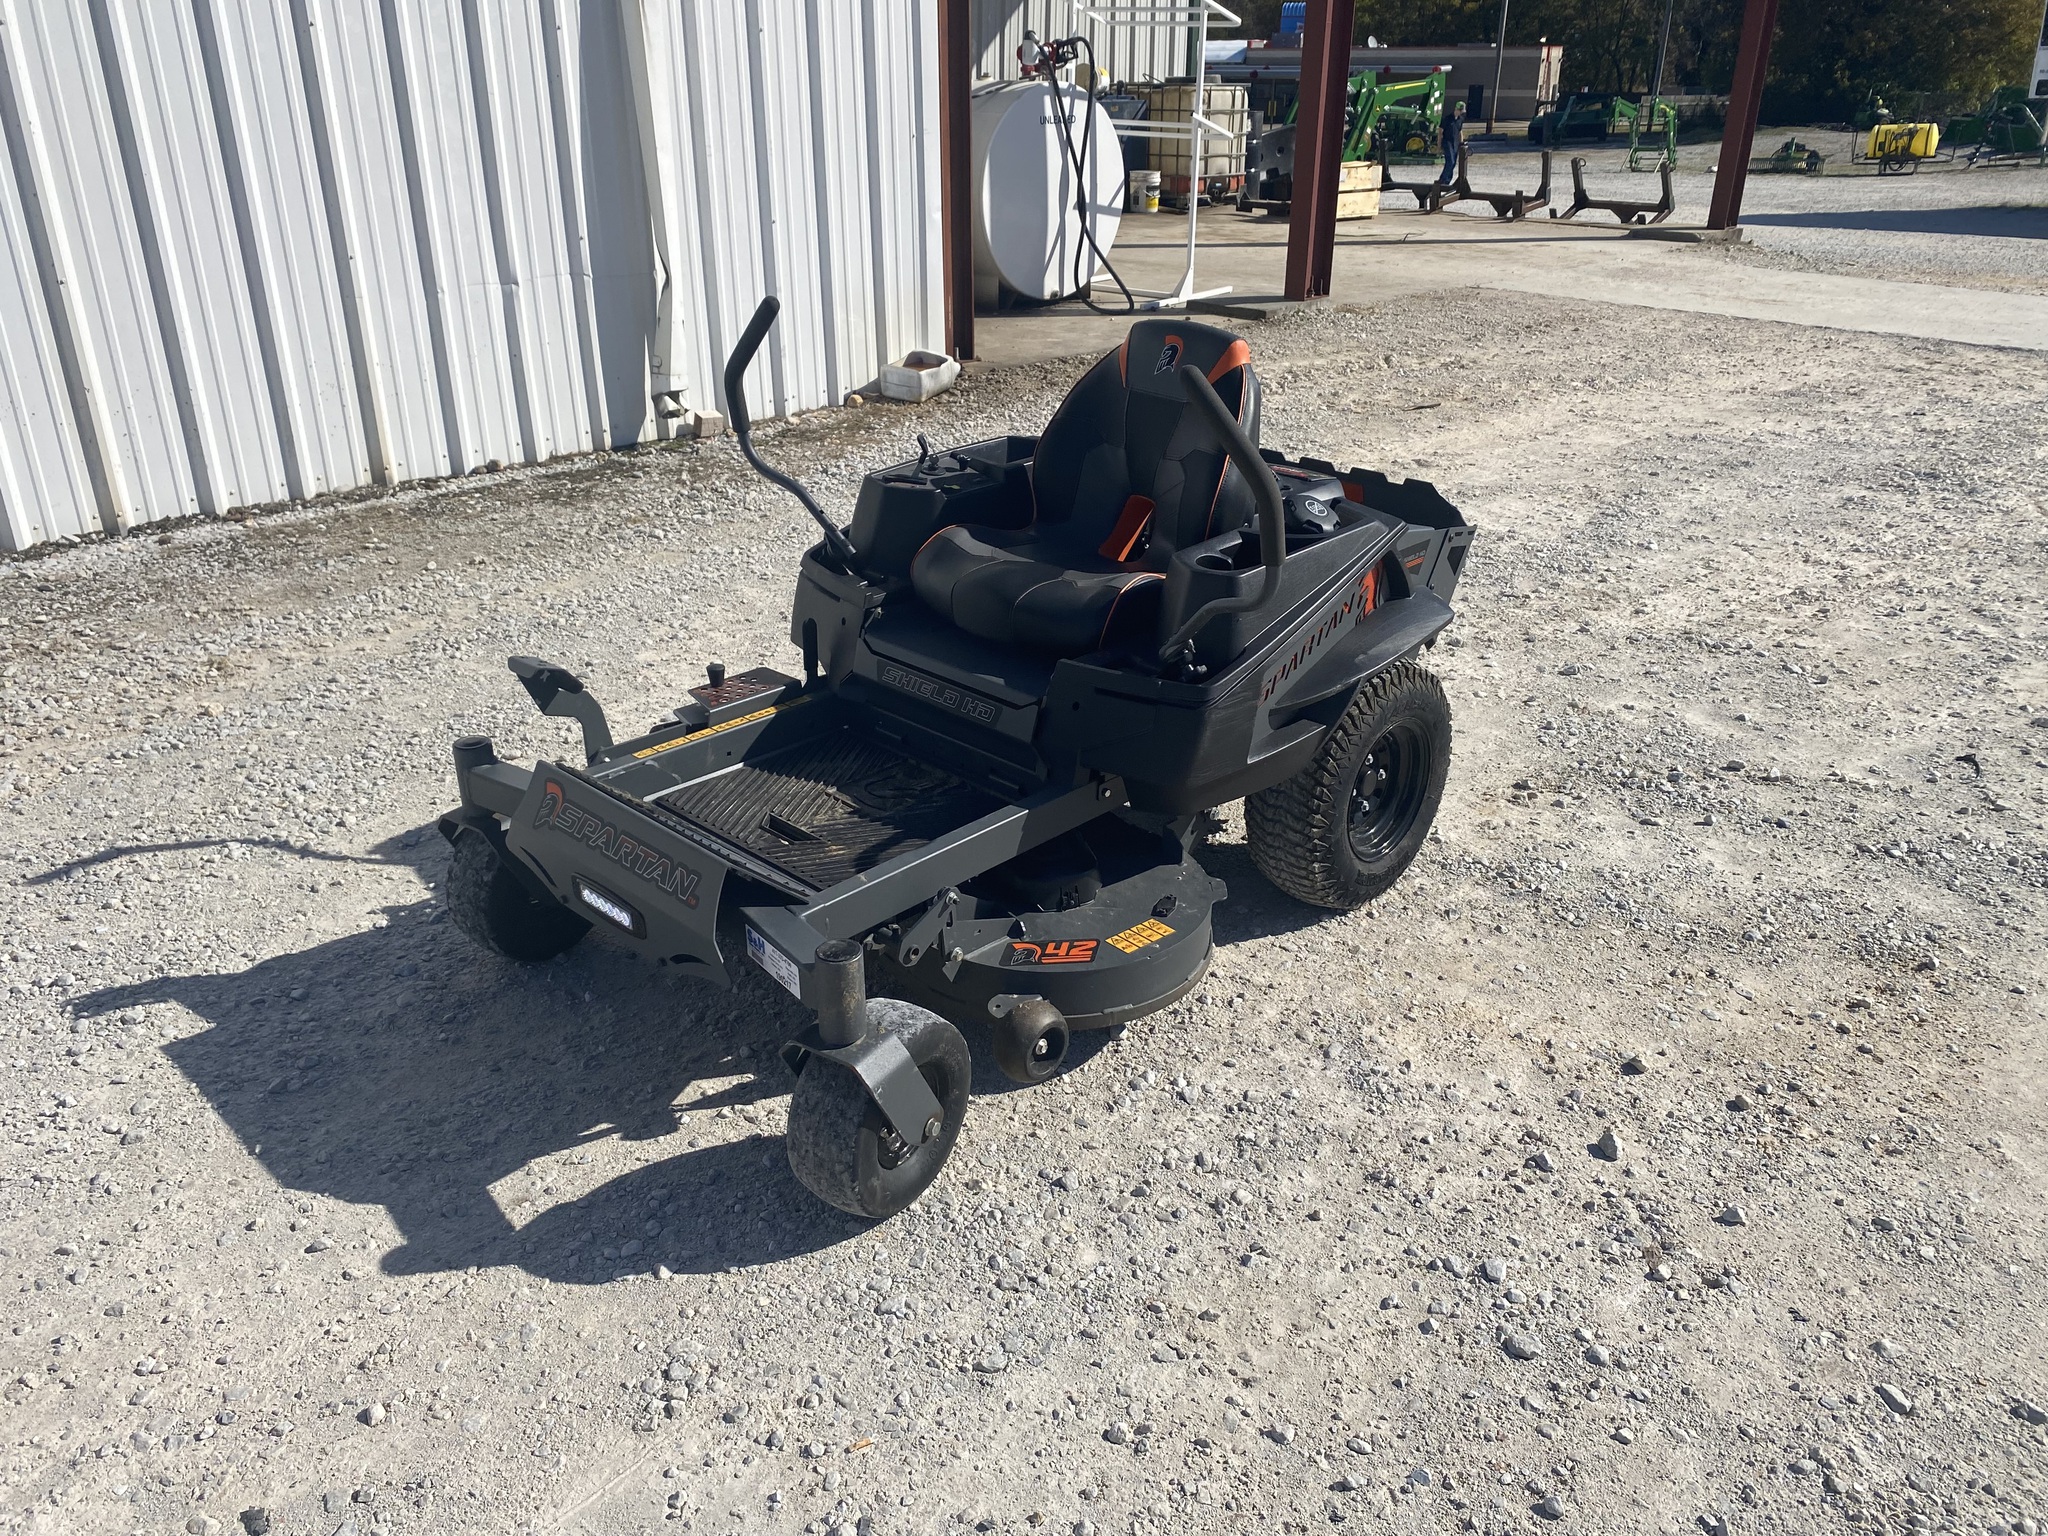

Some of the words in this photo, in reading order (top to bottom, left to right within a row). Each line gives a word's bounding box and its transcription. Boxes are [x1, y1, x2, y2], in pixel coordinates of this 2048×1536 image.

[1039, 115, 1076, 125] UNLEAED
[882, 666, 961, 708] SHIELD
[961, 697, 996, 722] HD
[554, 802, 698, 901] SPARTAN
[1044, 940, 1098, 957] 42
